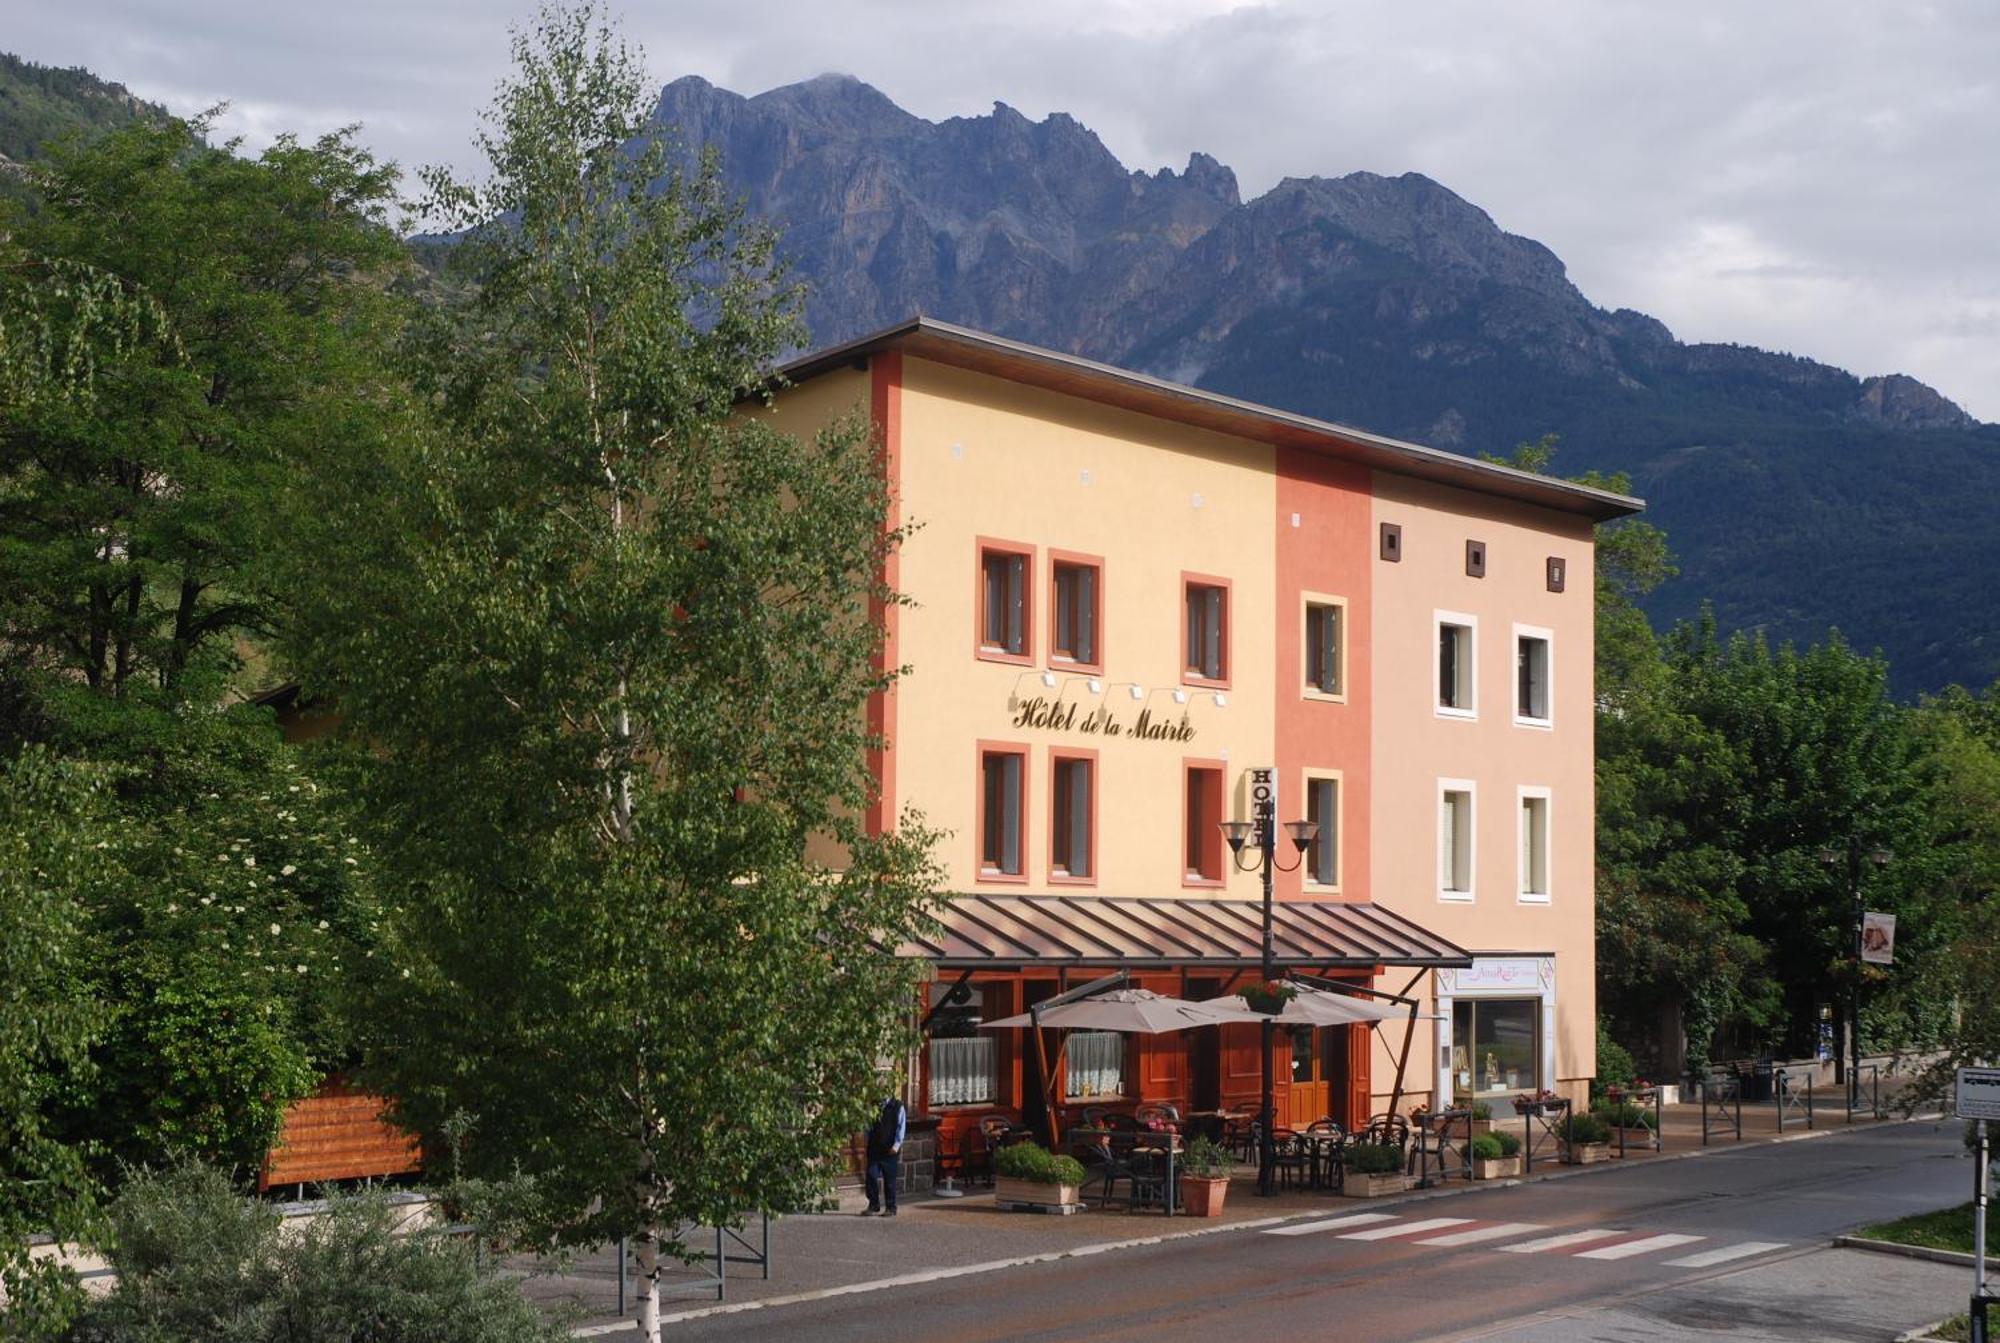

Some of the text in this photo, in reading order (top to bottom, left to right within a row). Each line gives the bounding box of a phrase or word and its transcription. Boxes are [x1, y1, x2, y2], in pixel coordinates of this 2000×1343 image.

[1013, 697, 1195, 742] Hôtel de la Mairie
